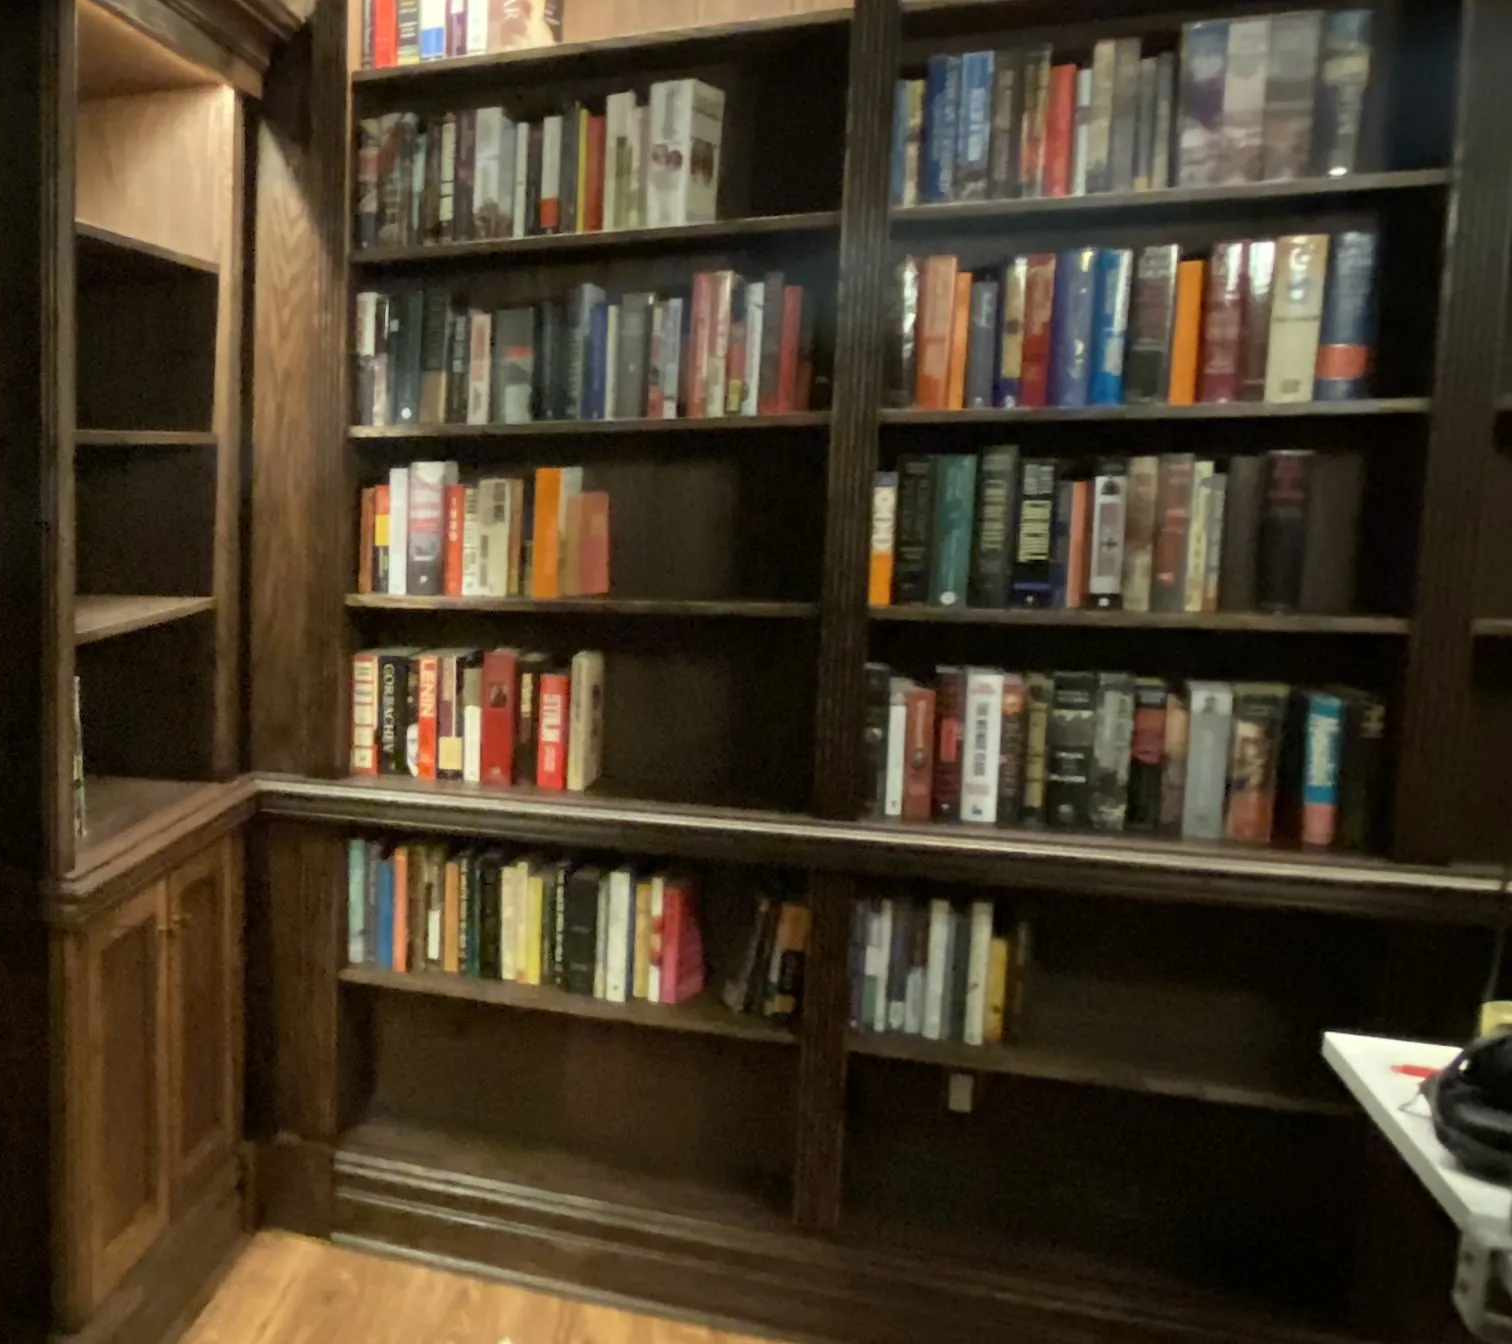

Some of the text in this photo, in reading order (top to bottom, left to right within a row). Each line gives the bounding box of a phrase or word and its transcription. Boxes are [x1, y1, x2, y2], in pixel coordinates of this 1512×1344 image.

[382, 663, 395, 753] GORBACHEV
[419, 659, 436, 718] LENIN
[541, 693, 562, 744] STALIN
